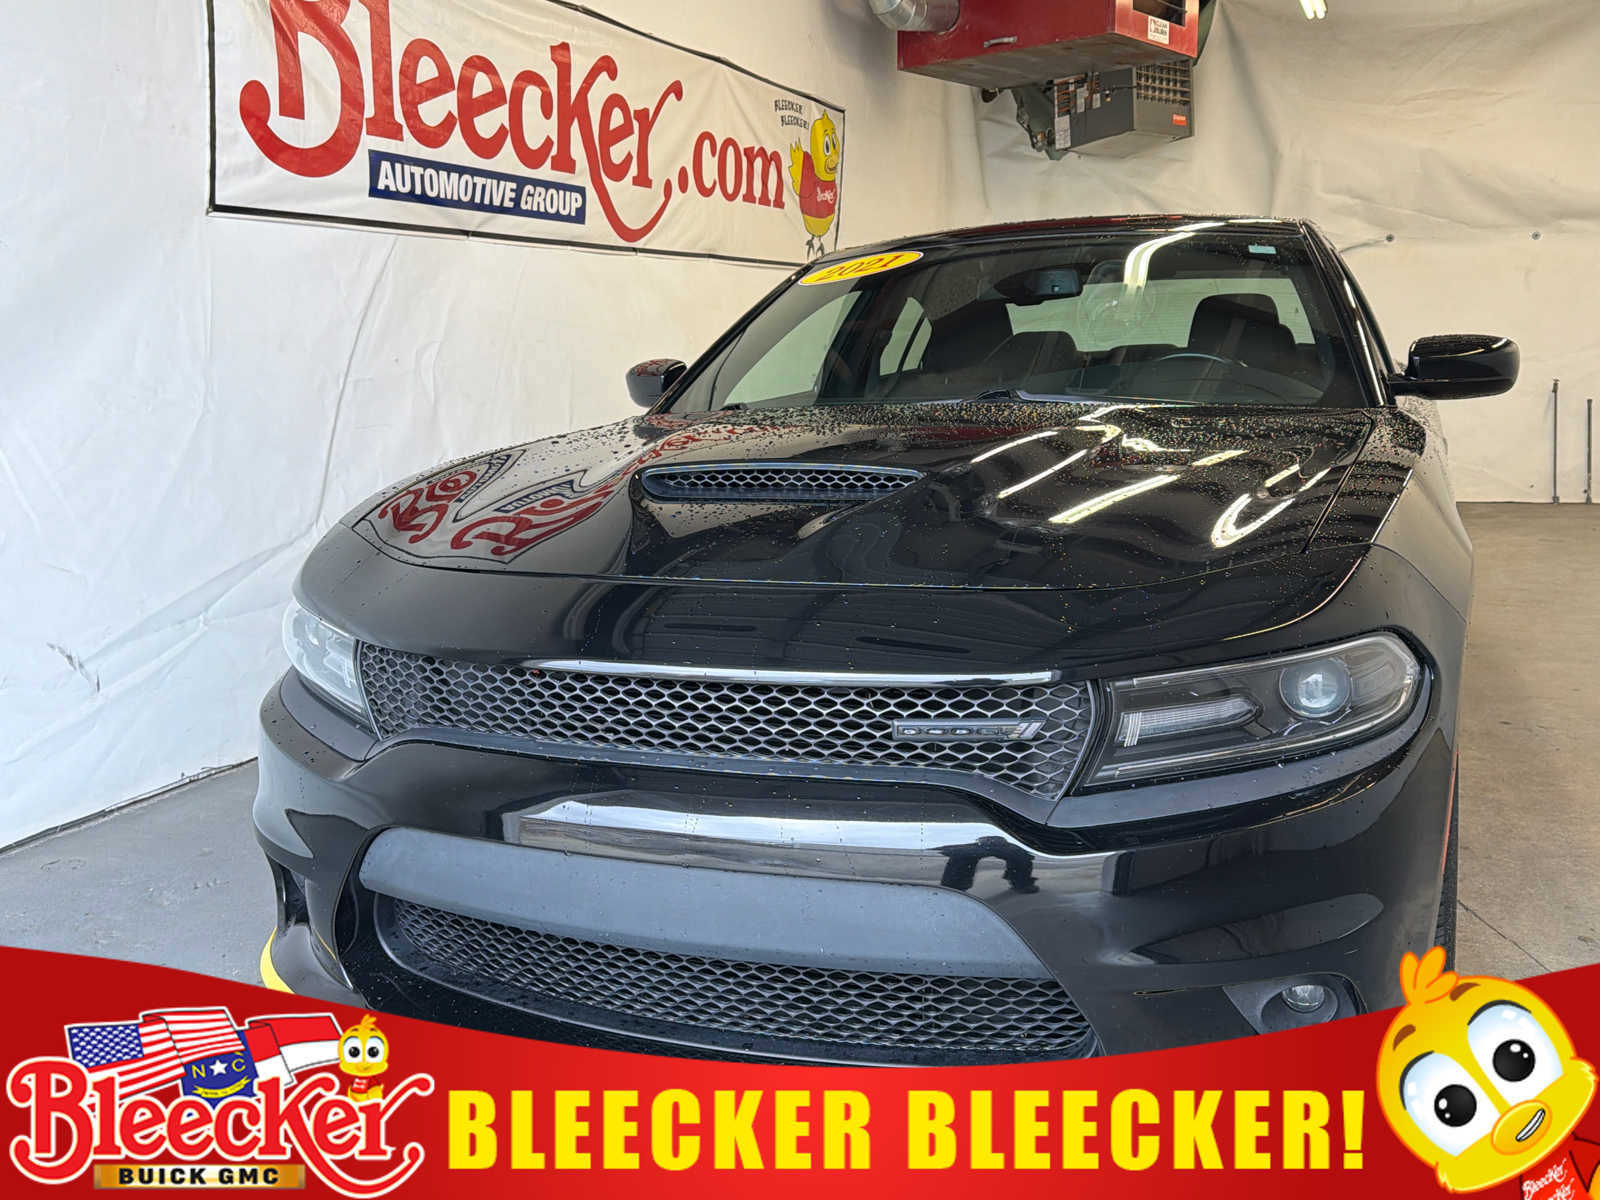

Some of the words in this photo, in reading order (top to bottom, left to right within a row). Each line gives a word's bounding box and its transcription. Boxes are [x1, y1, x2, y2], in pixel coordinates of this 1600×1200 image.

[377, 160, 517, 209] AUTOMOTIVE
[520, 184, 583, 217] GROUP
[815, 254, 905, 281] 2021
